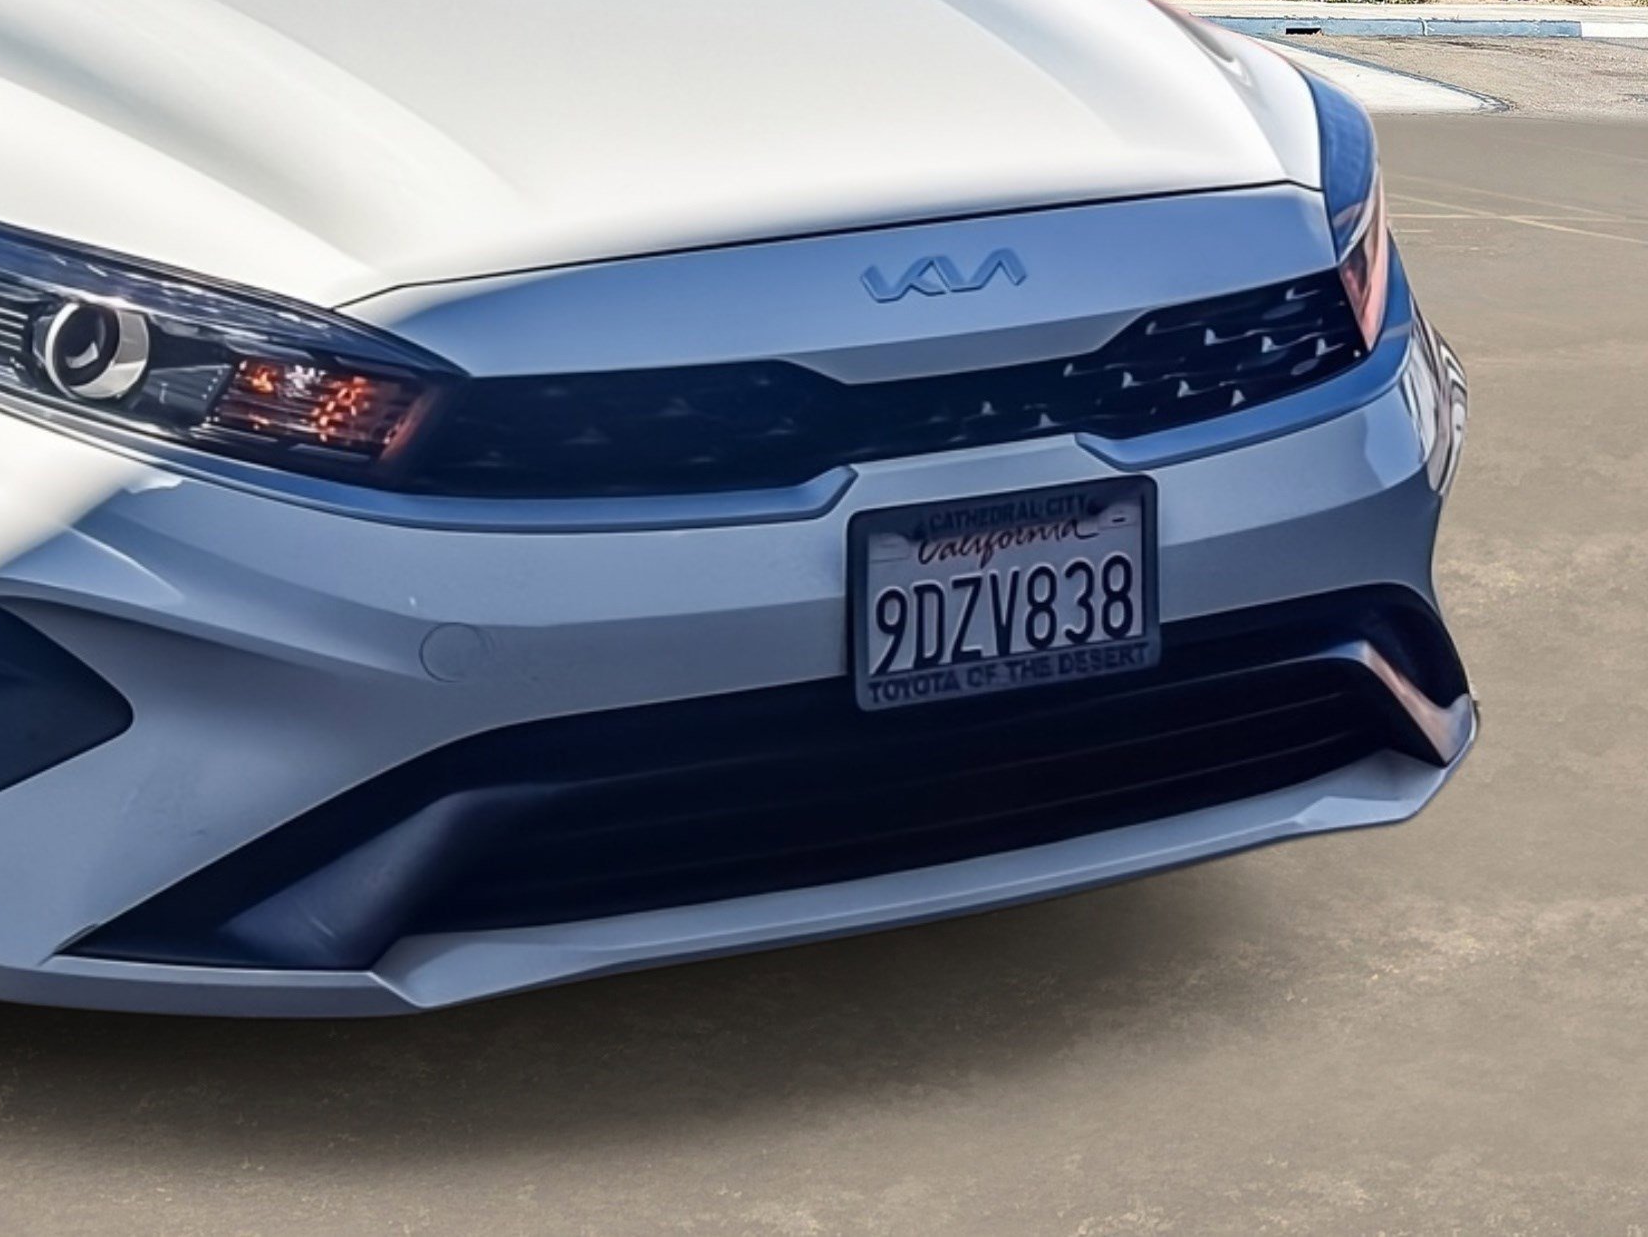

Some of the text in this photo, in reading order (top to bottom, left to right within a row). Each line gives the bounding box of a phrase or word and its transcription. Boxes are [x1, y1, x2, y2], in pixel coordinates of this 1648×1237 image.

[860, 248, 1028, 304] KIA
[929, 493, 1089, 531] CATHEDRAL CITY
[918, 517, 1100, 569] California
[870, 554, 1134, 678] 9DZV838
[868, 641, 1150, 704] TOYOTA OF THE DESERT
